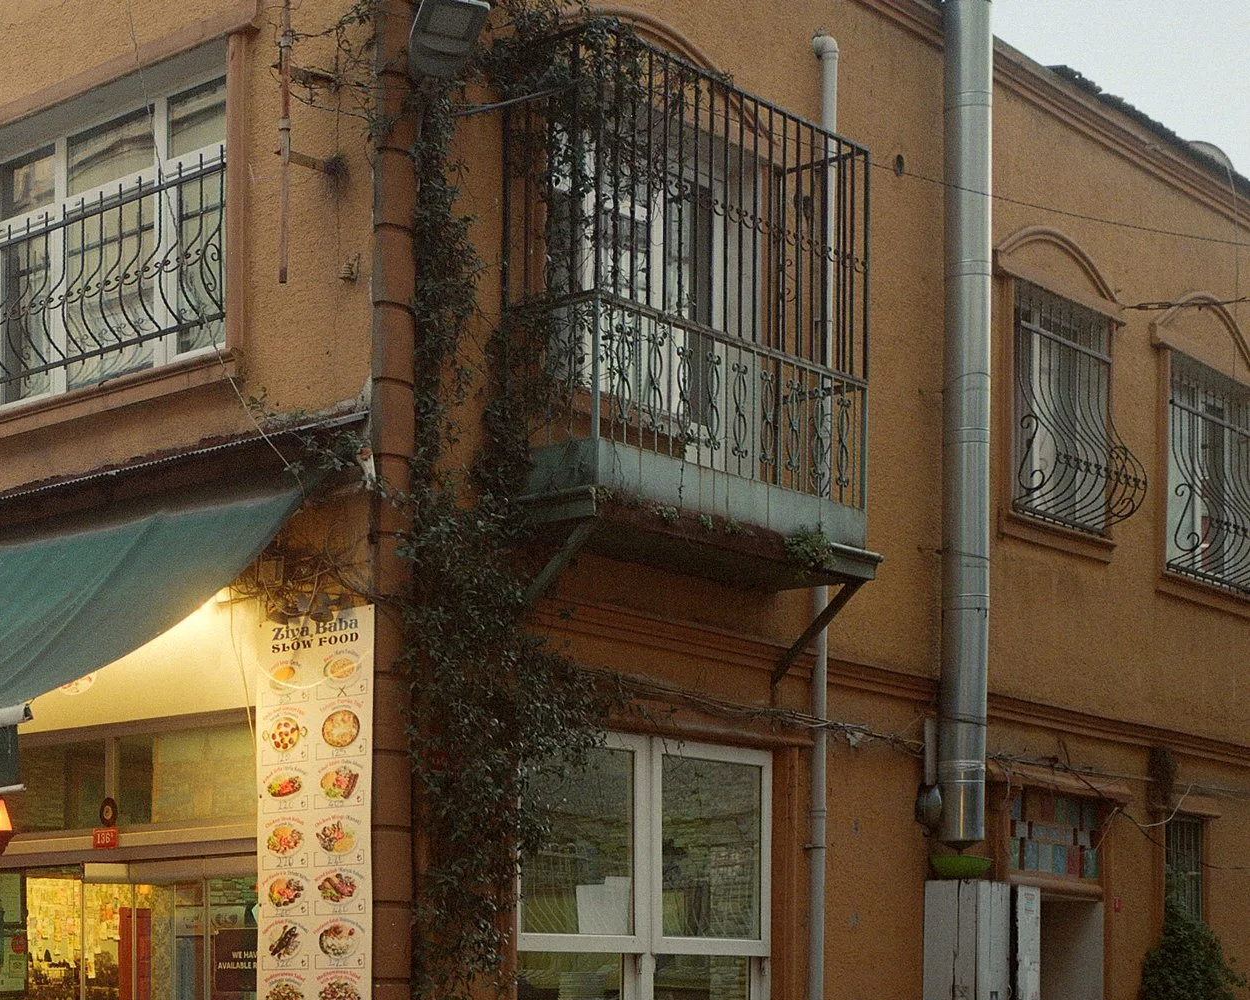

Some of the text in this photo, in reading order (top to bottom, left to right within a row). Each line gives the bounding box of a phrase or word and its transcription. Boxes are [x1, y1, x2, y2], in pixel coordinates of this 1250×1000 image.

[272, 618, 358, 641] Ziya Baba
[272, 632, 359, 653] SLOW FOOD
[231, 951, 242, 959] WE
[217, 961, 252, 970] AVAILABLE
